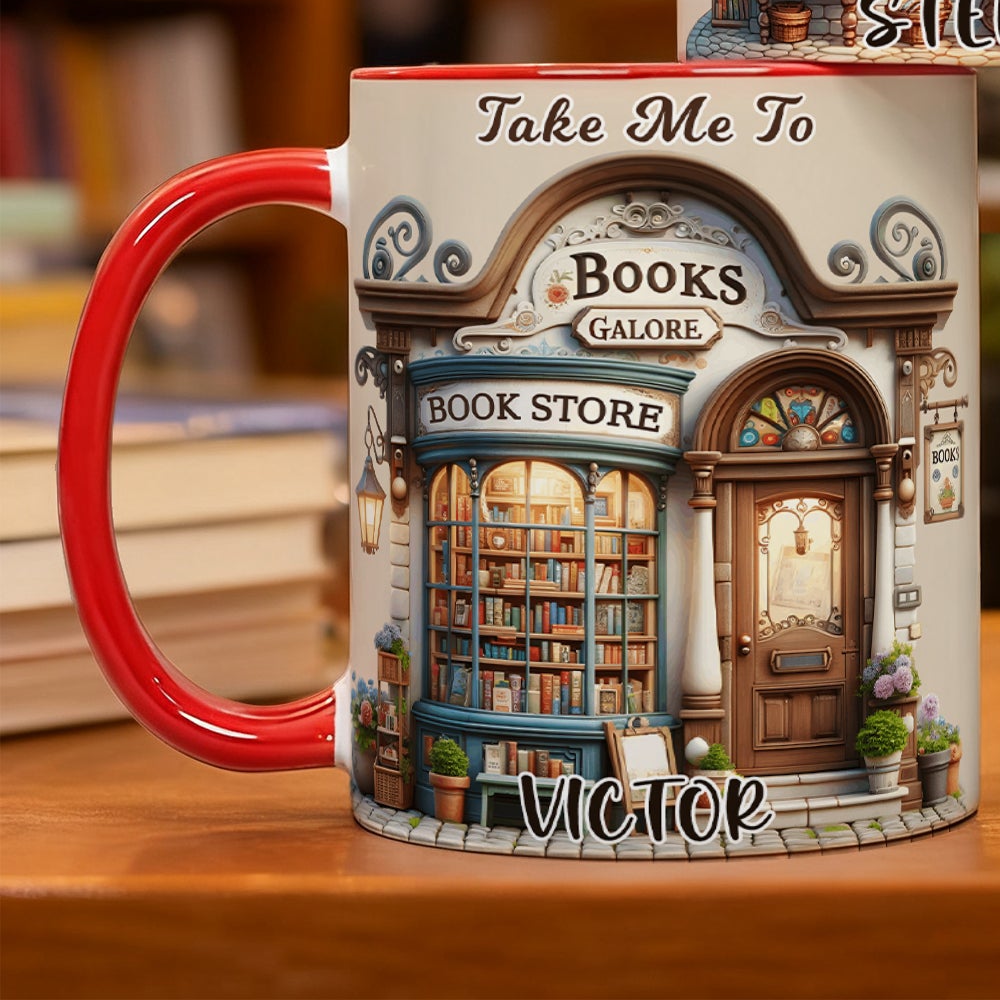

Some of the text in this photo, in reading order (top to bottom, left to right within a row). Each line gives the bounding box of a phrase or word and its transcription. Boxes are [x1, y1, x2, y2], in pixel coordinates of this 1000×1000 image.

[478, 95, 813, 143] Take Me To
[427, 392, 664, 433] BOOK STORE
[932, 446, 960, 465] BOOKS
[518, 773, 773, 842] VICTOR
